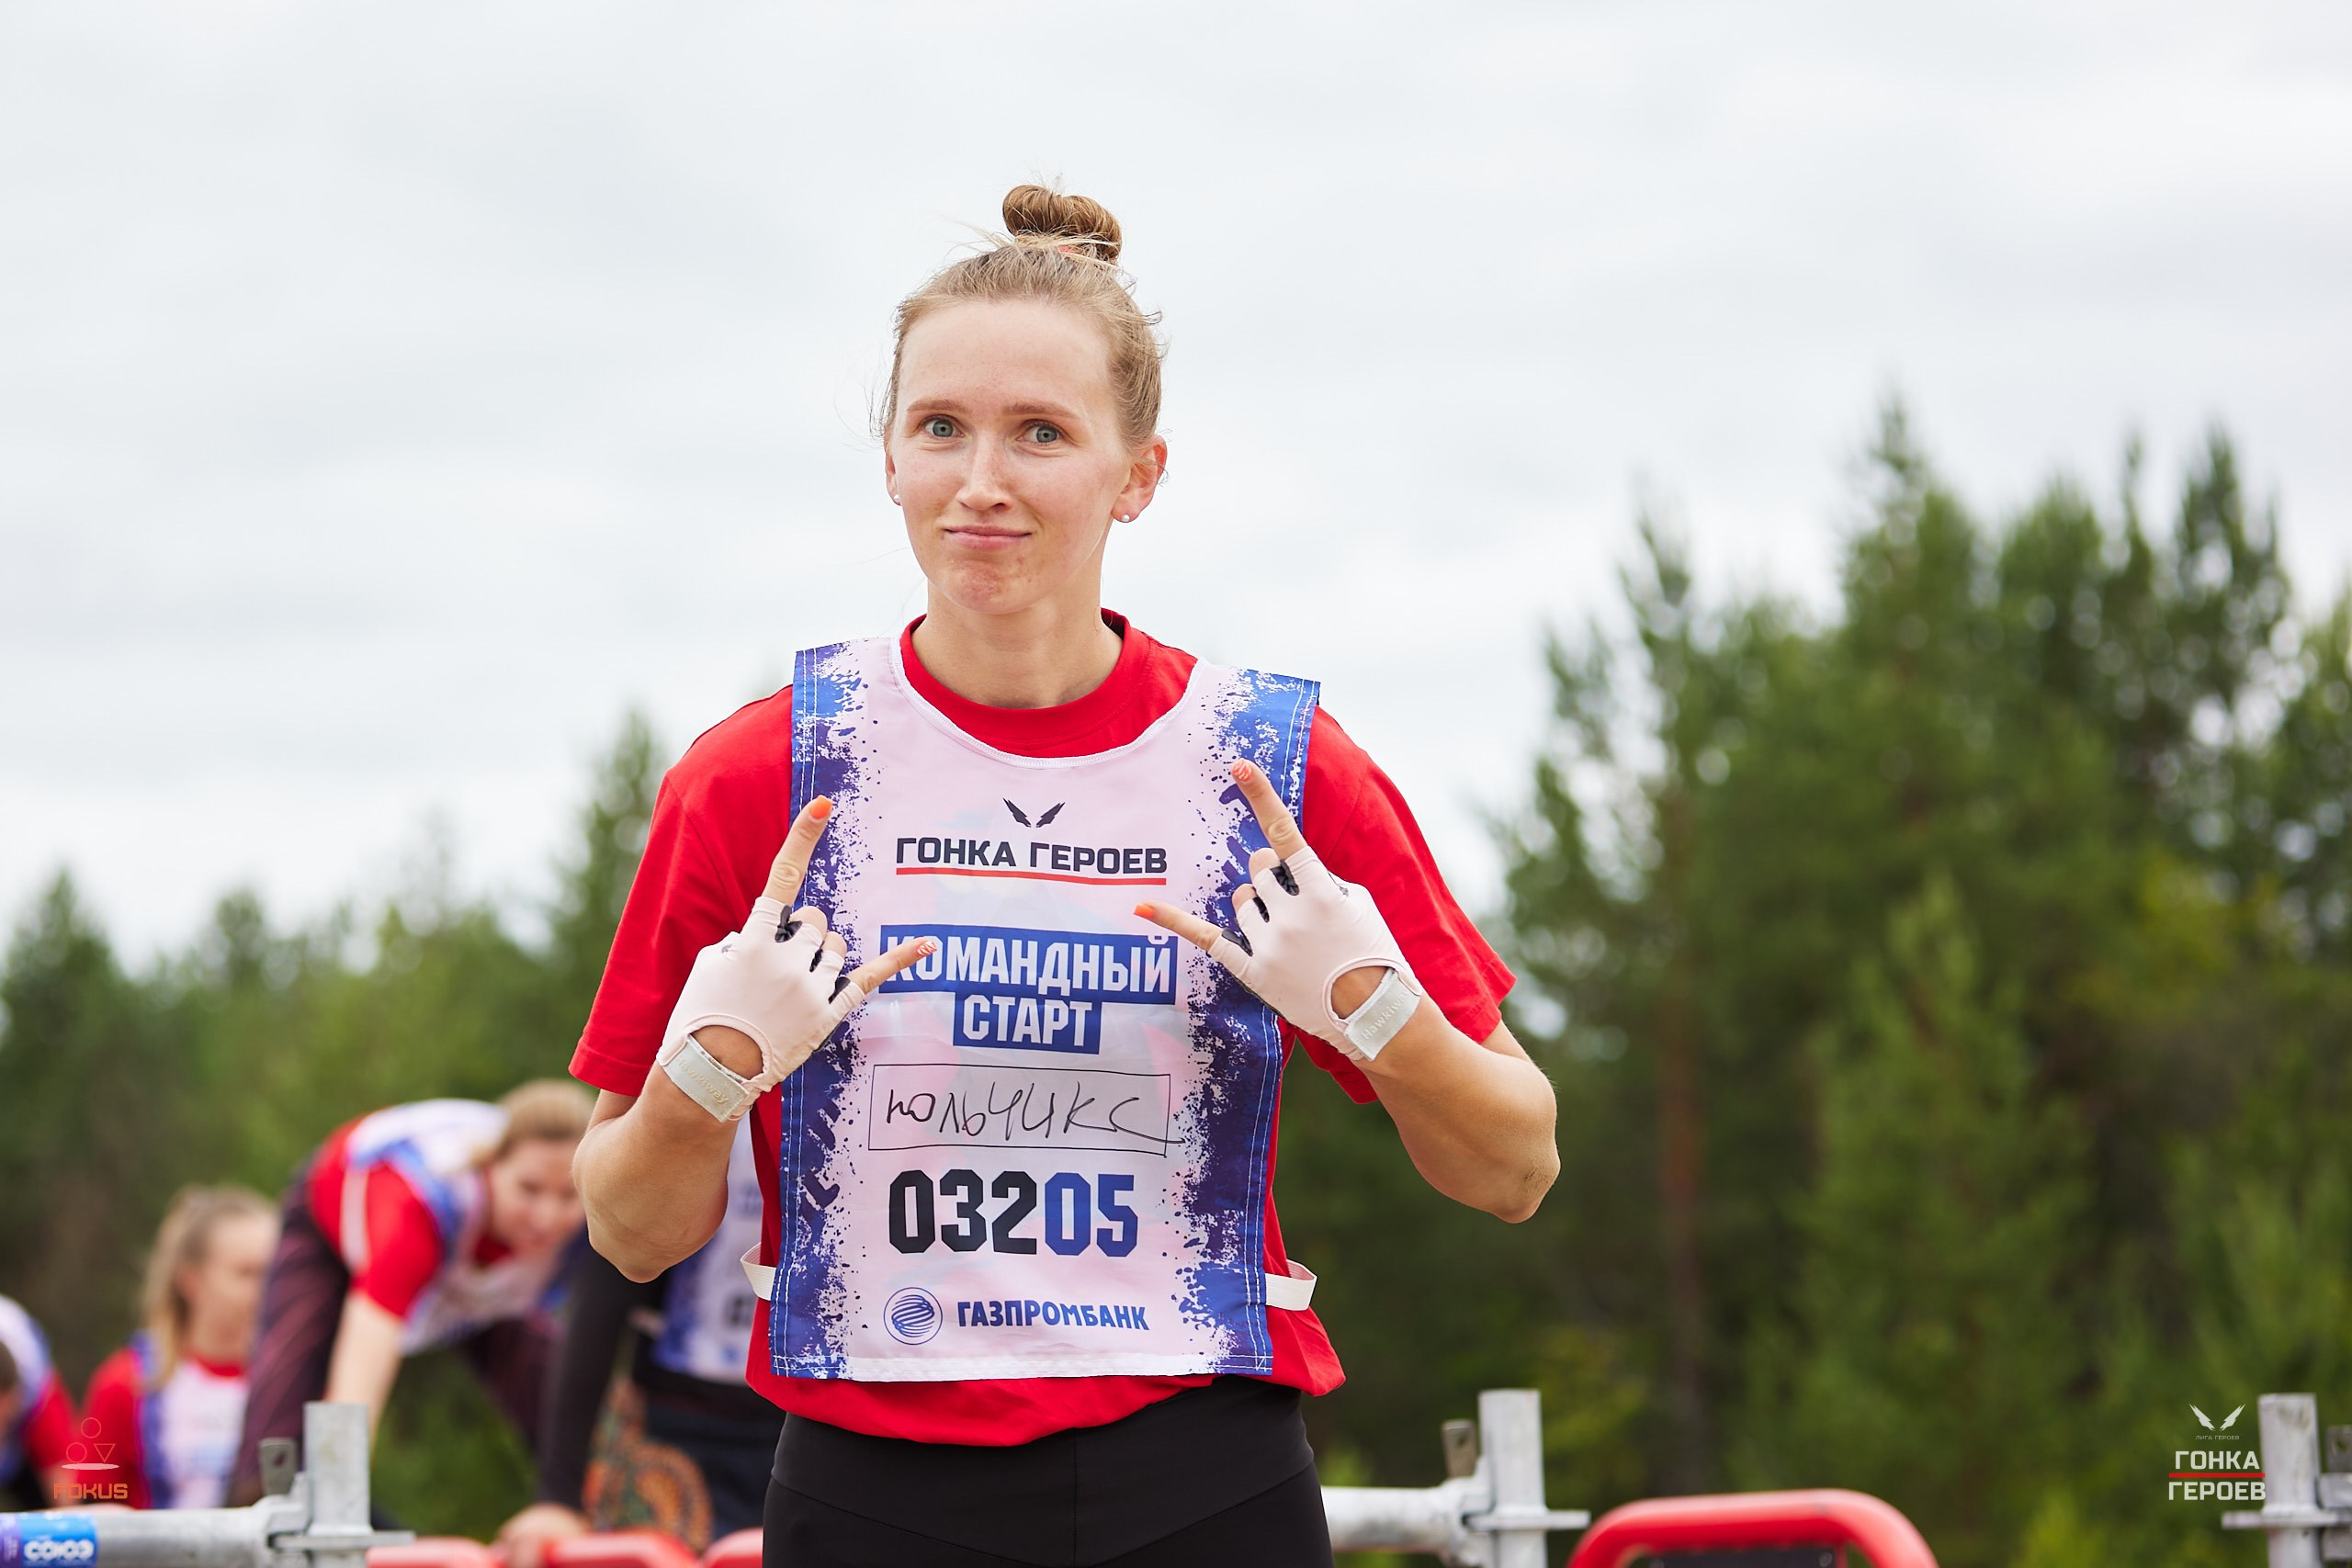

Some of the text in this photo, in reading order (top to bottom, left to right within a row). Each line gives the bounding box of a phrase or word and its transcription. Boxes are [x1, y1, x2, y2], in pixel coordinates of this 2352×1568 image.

[896, 837, 1167, 874] ГОНКА ГЕРОЕВ
[963, 995, 1092, 1047] СТАРТ
[1362, 991, 1409, 1040] Hawkiwa
[888, 1169, 1139, 1257] 03205
[957, 1300, 1150, 1331] ГАЗПРОМБАНК
